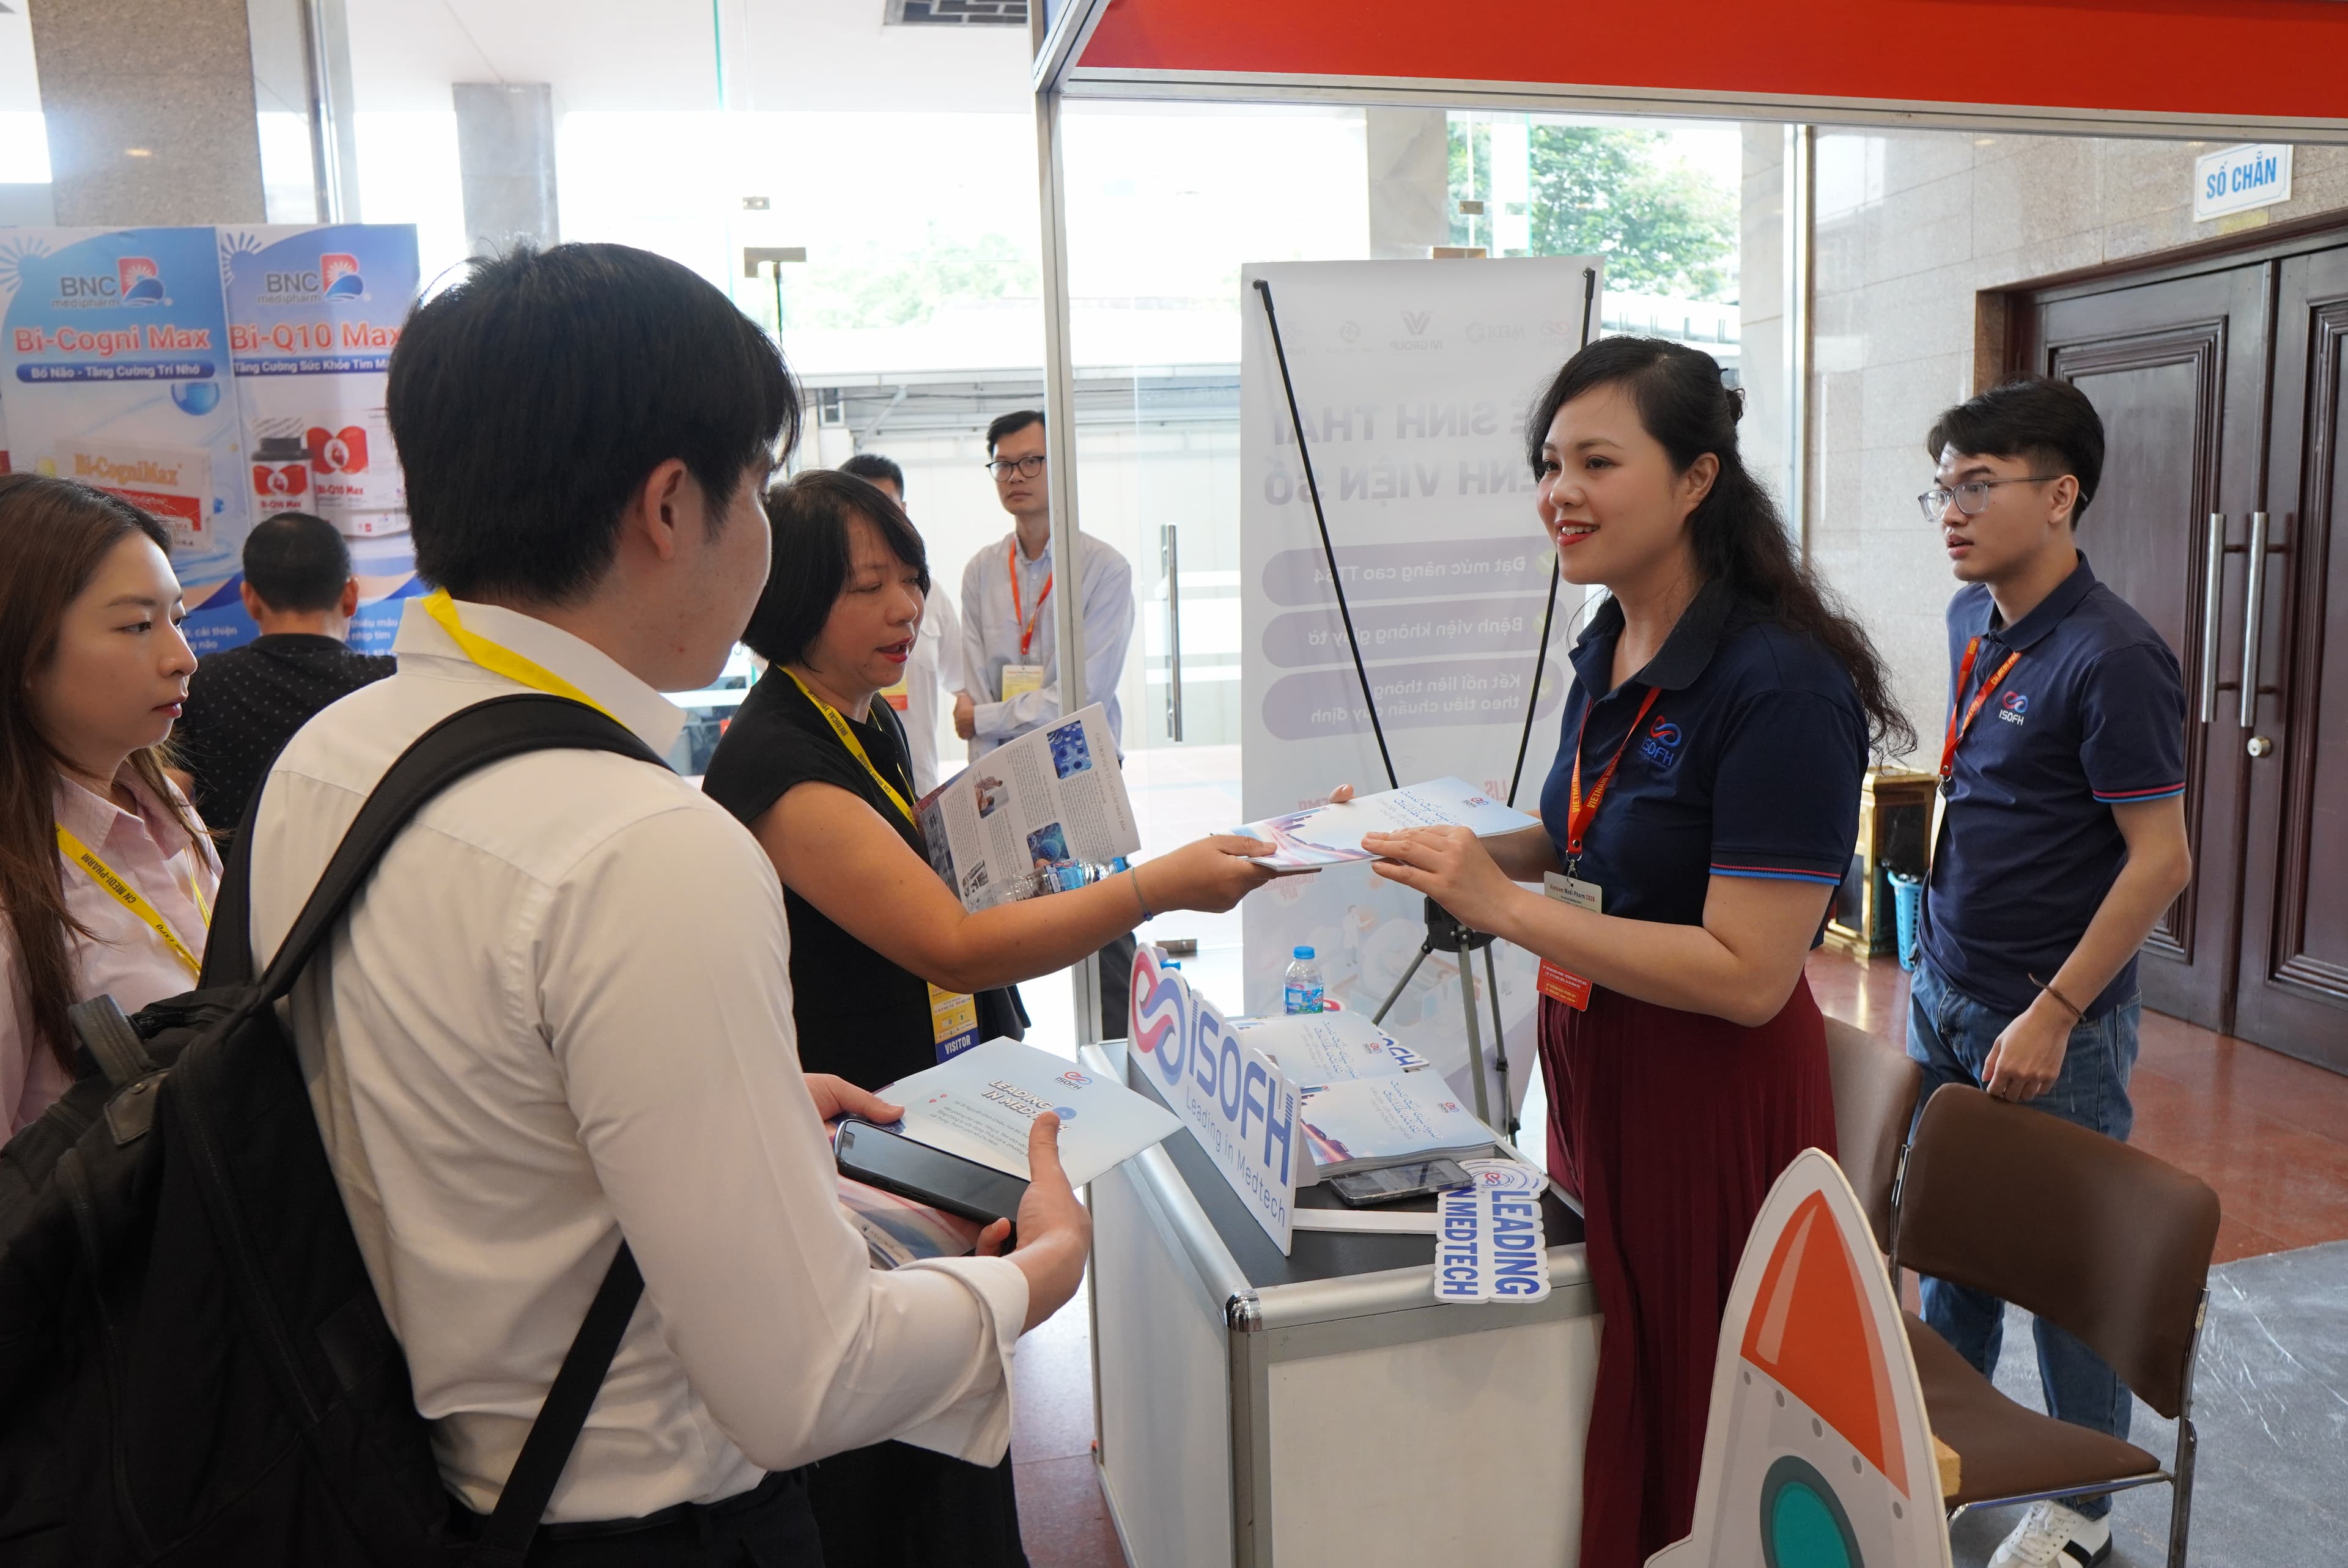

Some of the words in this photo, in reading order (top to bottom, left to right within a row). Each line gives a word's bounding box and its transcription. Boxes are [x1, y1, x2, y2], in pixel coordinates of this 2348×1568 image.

[2206, 161, 2227, 200] SỐ
[61, 276, 116, 297] BNC
[267, 273, 319, 293] BNC
[14, 324, 141, 357] Bi-Cogni
[147, 324, 212, 351] Max
[230, 322, 334, 354] Bi-Q10
[341, 322, 402, 348] Max
[352, 358, 374, 370] Tim
[827, 712, 849, 737] MEDICAL
[1999, 709, 2025, 726] ISOFH
[1641, 736, 1675, 766] ISOFH
[1587, 775, 1609, 809] VIETNAM
[80, 853, 128, 896] MEDI-PHARM
[122, 891, 137, 905] CN
[155, 924, 175, 943] EXPO
[945, 1034, 971, 1055] VISITOR
[988, 1080, 1054, 1110] LEADING
[1054, 1076, 1082, 1091] ISOFH
[1189, 999, 1291, 1188] ISOFH
[981, 1089, 1005, 1101] IN
[1000, 1097, 1071, 1133] MEDTH
[1186, 1086, 1222, 1154] Leading
[1224, 1132, 1234, 1164] in
[1237, 1154, 1285, 1228] Medtech
[1442, 1202, 1479, 1295] MEDTECH
[1491, 1190, 1540, 1295] LEADING
